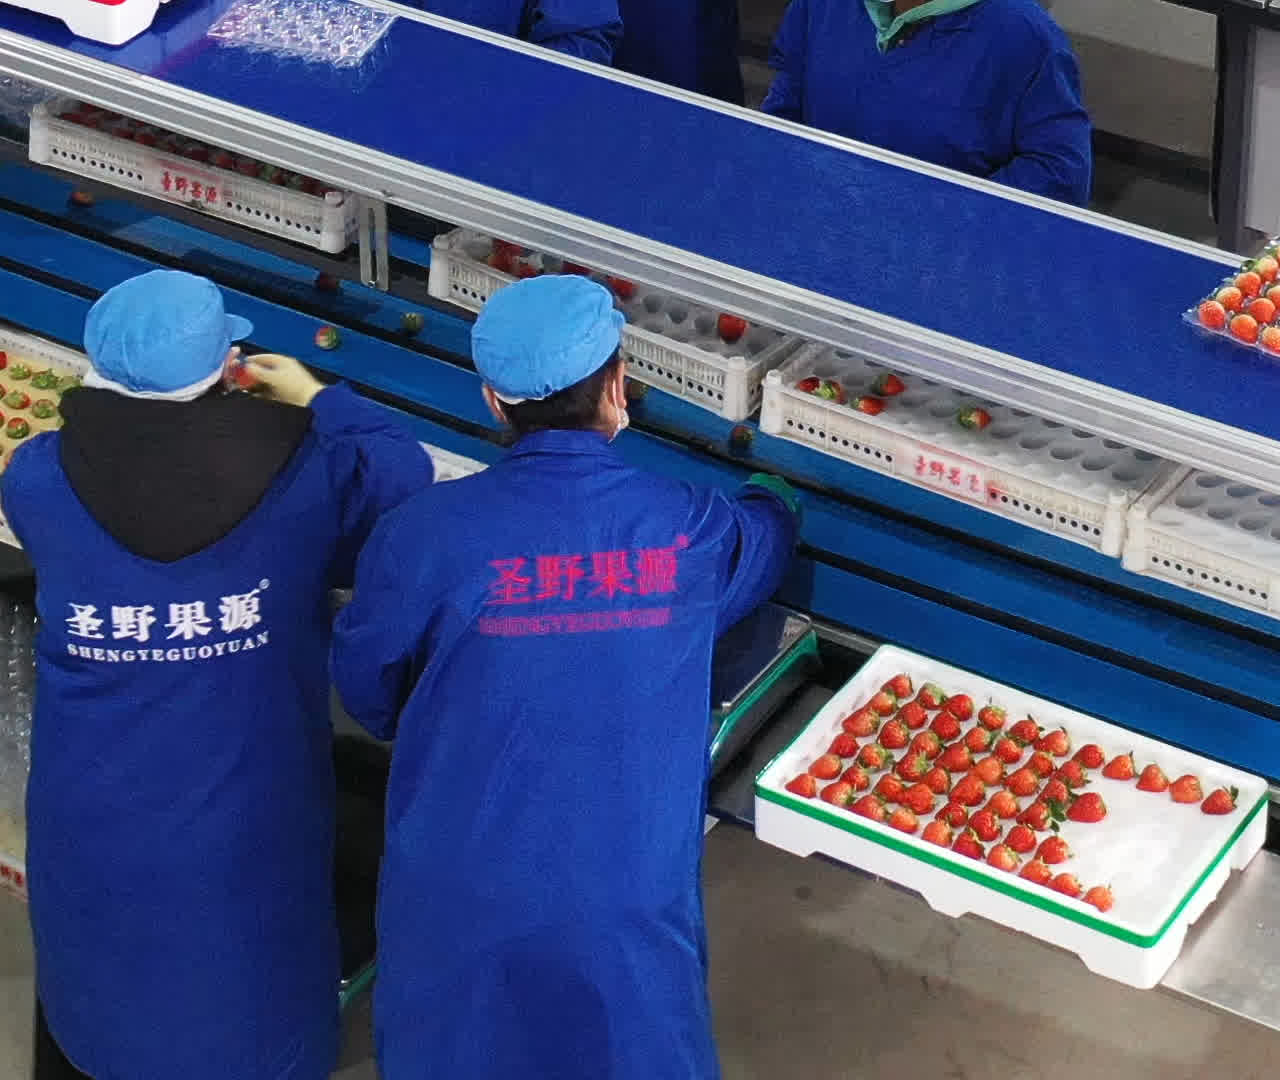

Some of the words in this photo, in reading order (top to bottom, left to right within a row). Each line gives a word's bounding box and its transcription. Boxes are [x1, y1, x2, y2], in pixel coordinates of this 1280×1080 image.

[483, 545, 679, 605] 圣野果源
[65, 588, 263, 643] 圣野果源
[67, 630, 269, 662] SHENGYEGUOYUAN
